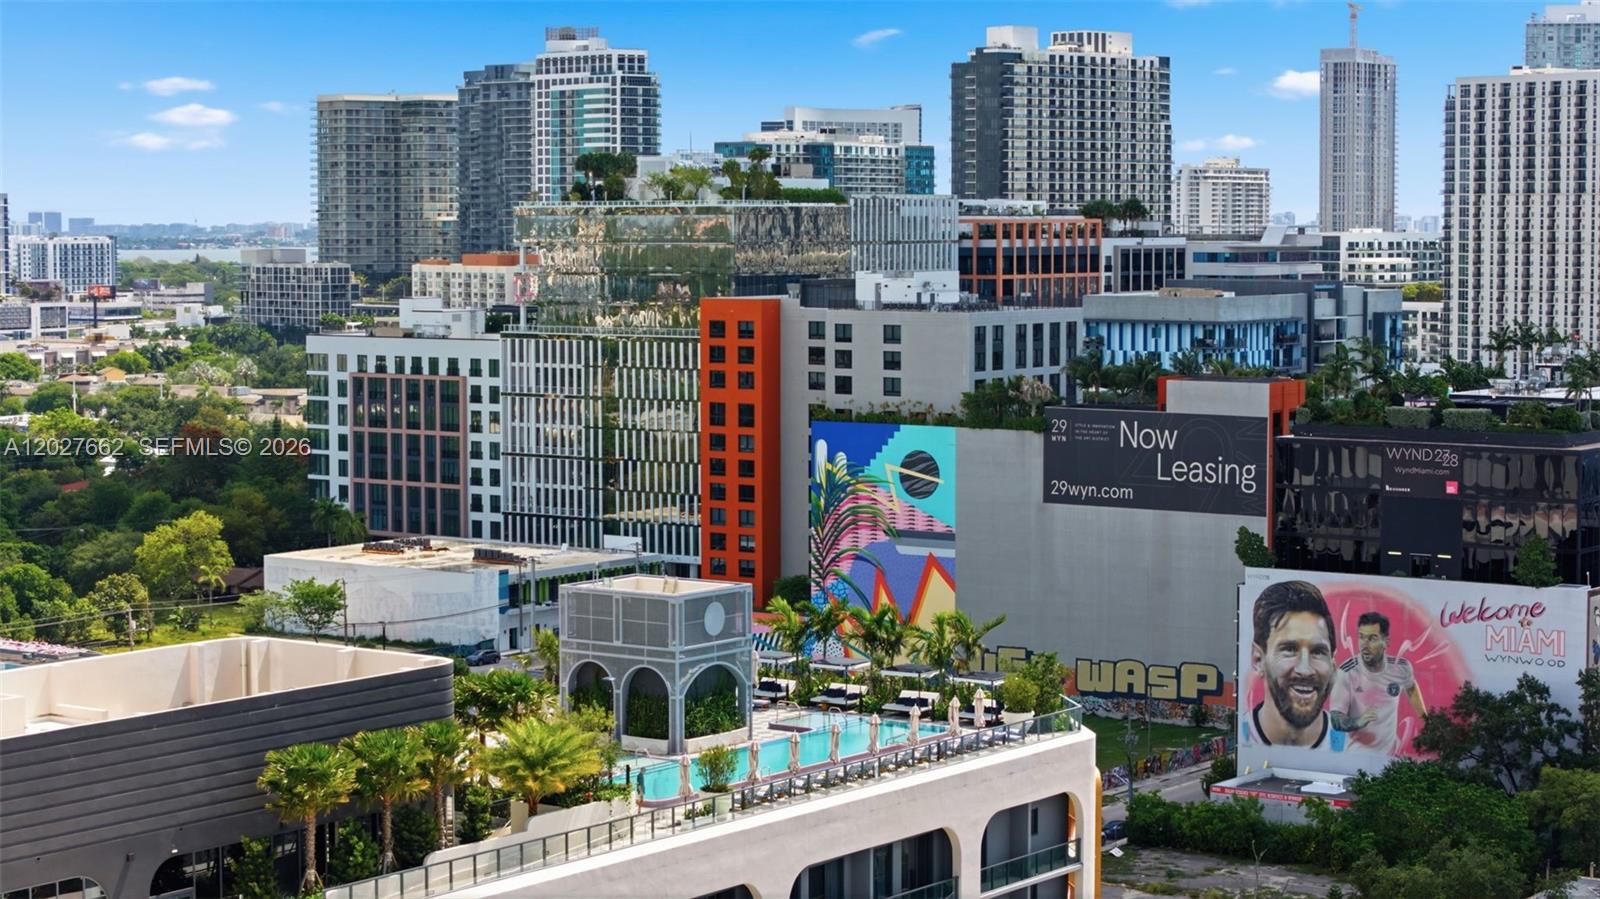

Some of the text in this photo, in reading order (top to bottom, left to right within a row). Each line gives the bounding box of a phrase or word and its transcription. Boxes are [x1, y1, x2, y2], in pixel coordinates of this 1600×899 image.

[1051, 418, 1068, 433] 29
[1119, 420, 1178, 450] Now
[1386, 447, 1433, 461] WYND
[1157, 453, 1257, 494] Leasing
[1394, 466, 1451, 476] WyndMiami.com
[1050, 480, 1134, 500] 29wyn.com
[1440, 597, 1546, 628] Welcome
[1485, 624, 1566, 657] MIAMI
[1485, 654, 1566, 668] WYNWOOD
[1076, 658, 1222, 703] WASP
